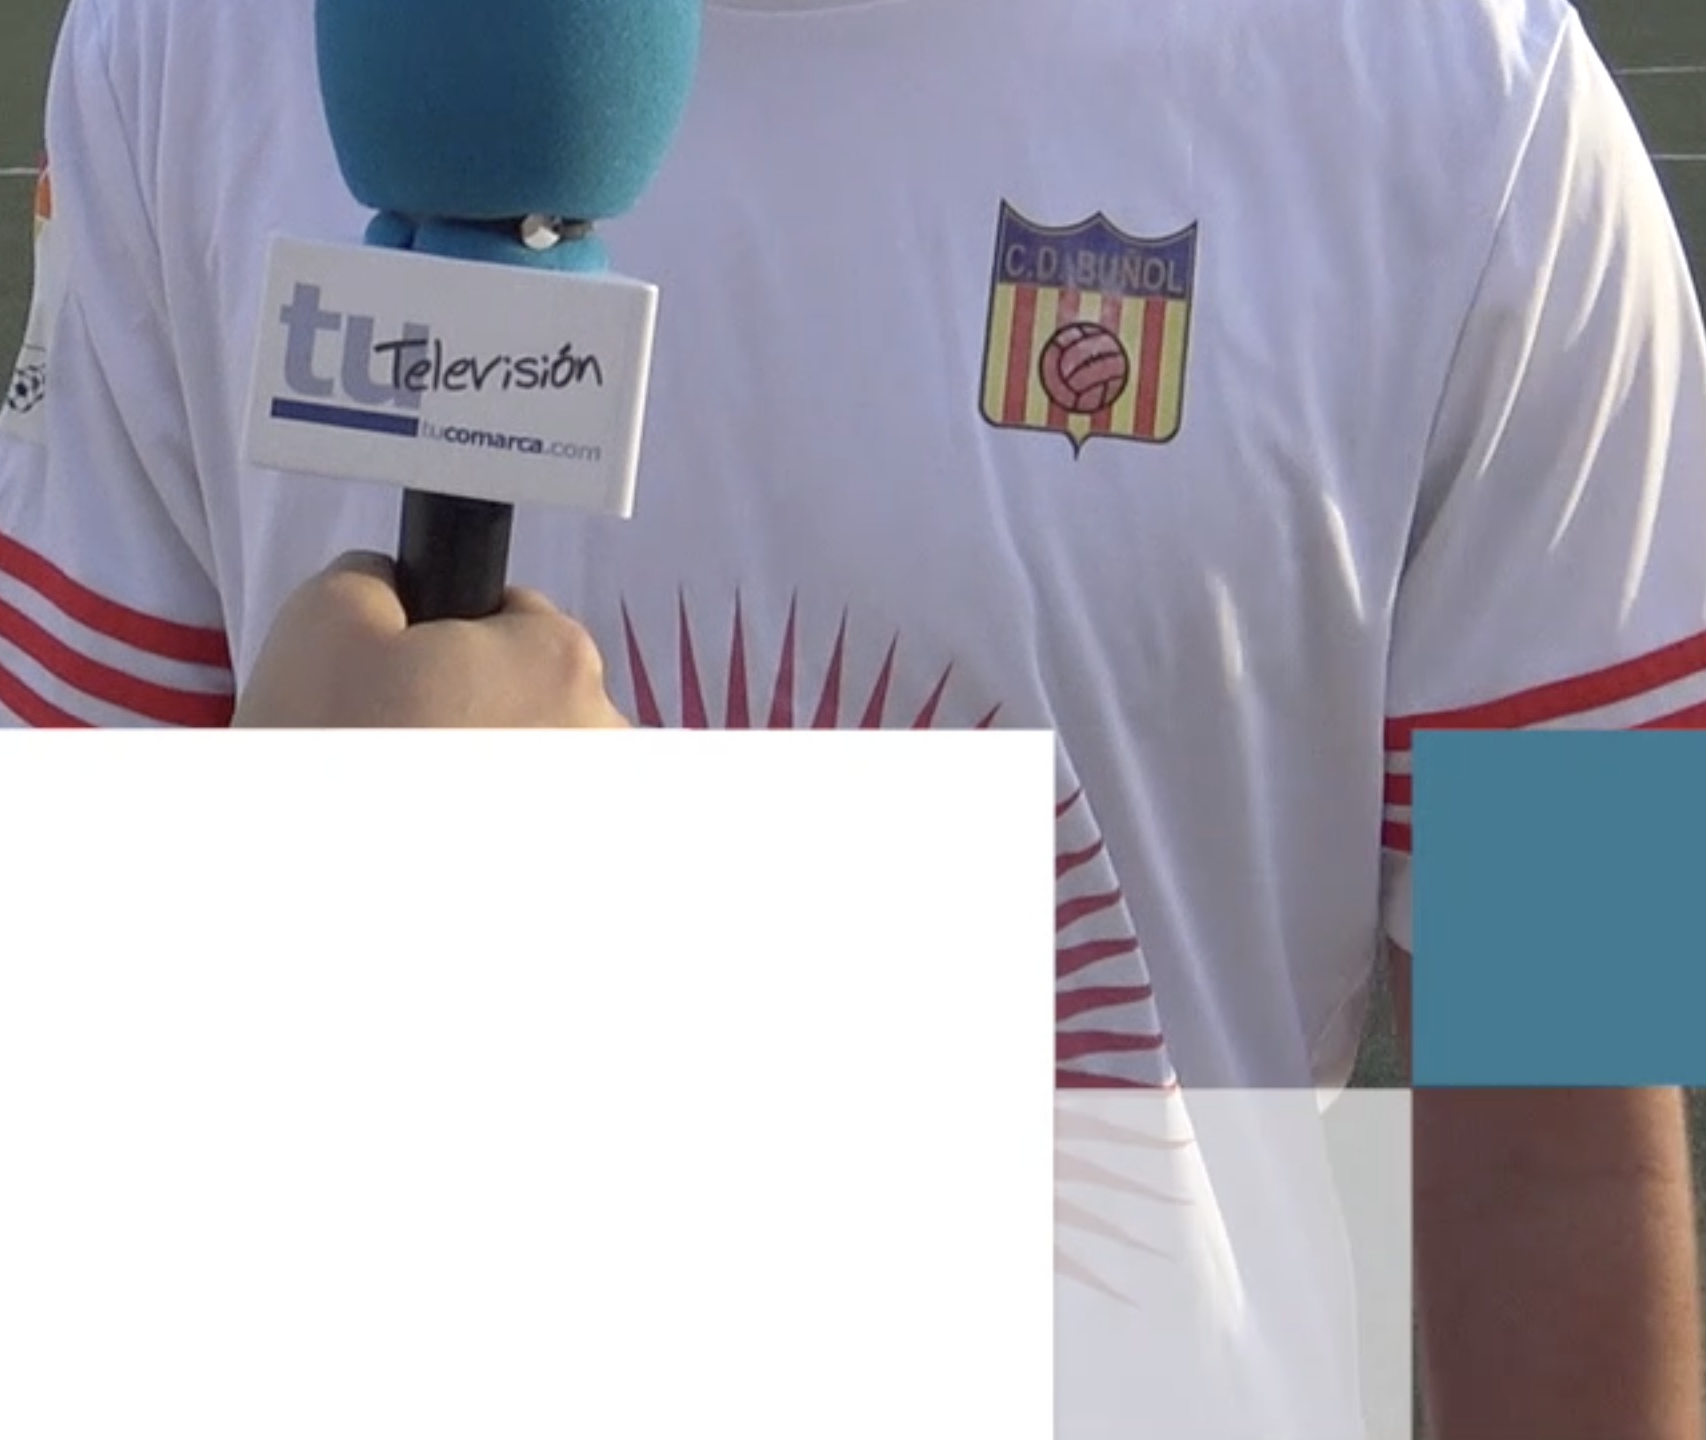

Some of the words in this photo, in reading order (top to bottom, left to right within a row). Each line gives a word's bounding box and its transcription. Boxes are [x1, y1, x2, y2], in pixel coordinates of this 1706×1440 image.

[1076, 249, 1184, 292] BUÑOL
[280, 282, 429, 409] tu
[374, 338, 603, 392] Televisión
[422, 418, 602, 462] tucomarca.com
